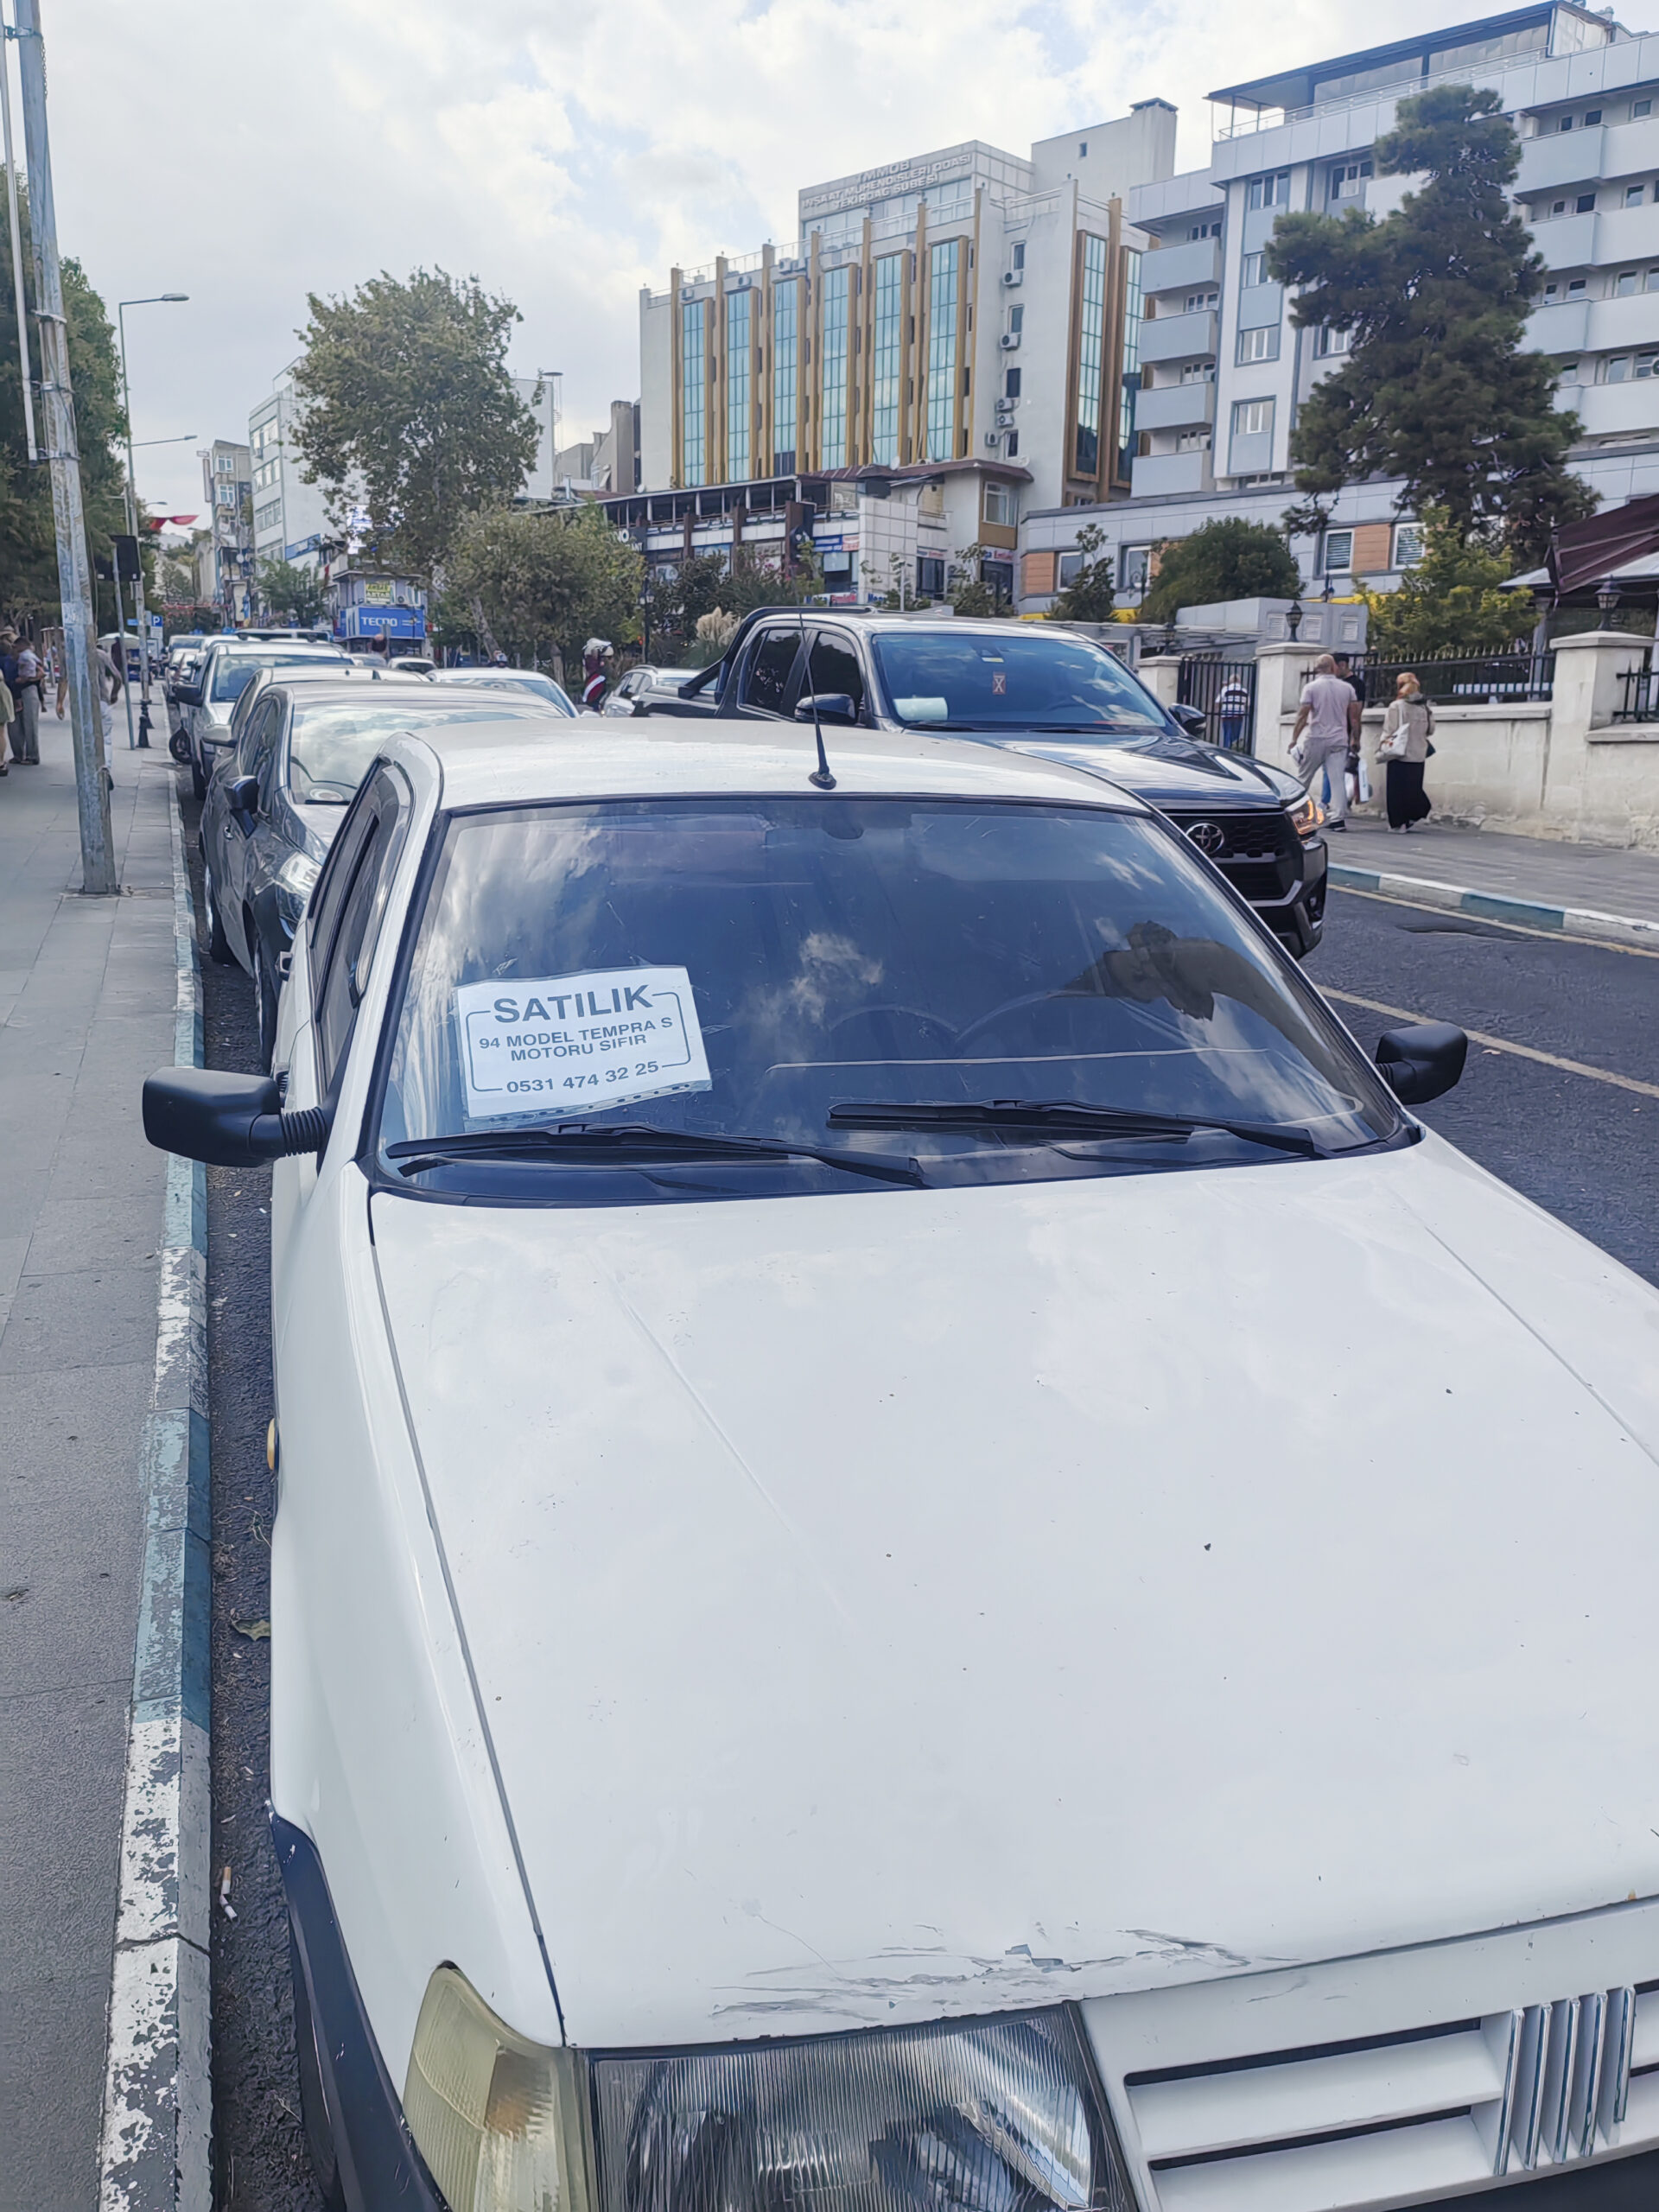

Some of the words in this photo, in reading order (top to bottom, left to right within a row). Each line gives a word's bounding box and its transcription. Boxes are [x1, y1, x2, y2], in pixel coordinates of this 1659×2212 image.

[153, 616, 160, 626] P
[360, 616, 397, 626] TECNO
[493, 984, 653, 1023] SATILIK
[479, 1037, 500, 1049] 94
[506, 1031, 574, 1047] MODEL
[579, 1020, 656, 1040] TEMPRA
[661, 1017, 673, 1028] S
[511, 1043, 594, 1061] MOTORU
[600, 1034, 647, 1052] SIFIR
[506, 1078, 554, 1093] 0531
[563, 1074, 599, 1089] 474
[605, 1067, 629, 1083] 32
[635, 1061, 659, 1076] 25
